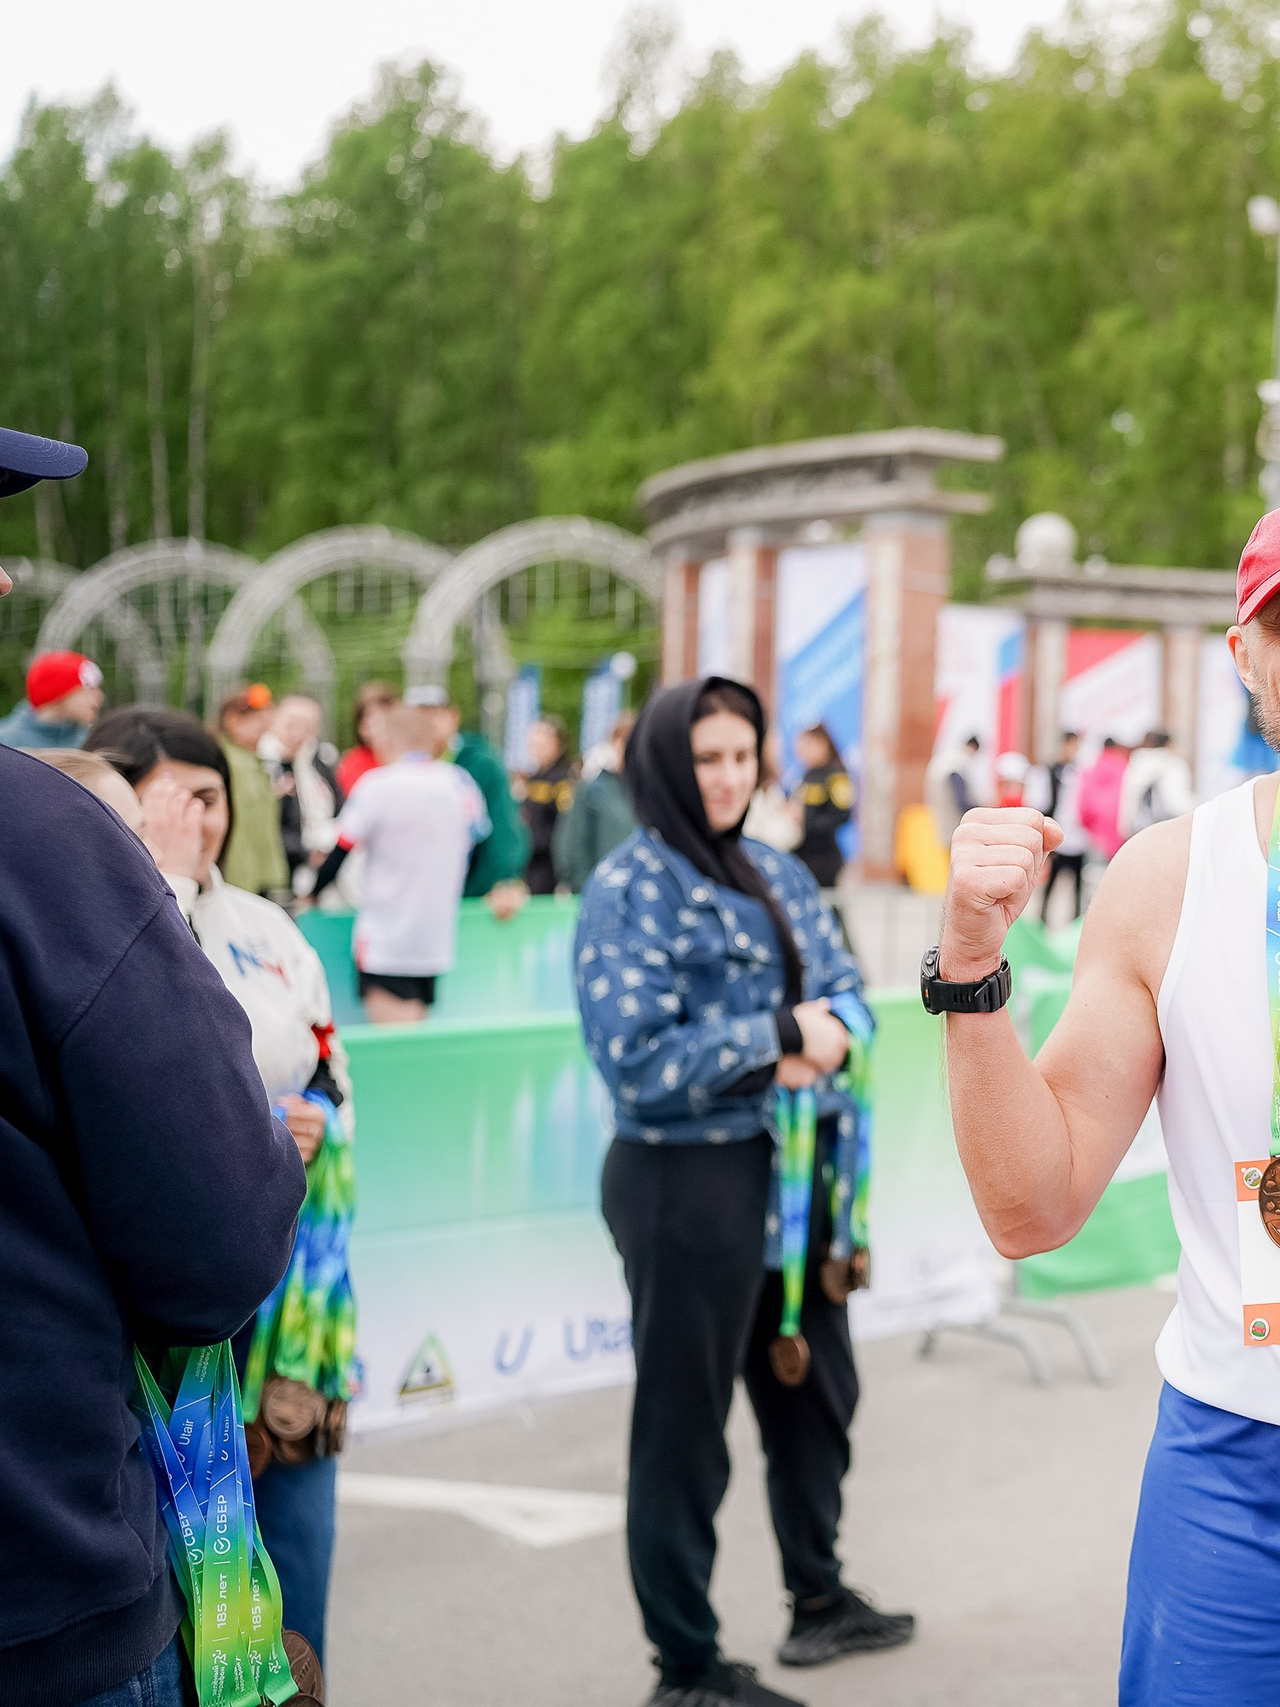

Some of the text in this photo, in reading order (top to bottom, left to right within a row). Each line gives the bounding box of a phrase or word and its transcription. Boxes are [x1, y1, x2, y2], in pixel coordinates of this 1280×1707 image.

[563, 1318, 633, 1363] Uta
[179, 1418, 194, 1446] Utair
[178, 1511, 196, 1547] СБЕР
[216, 1494, 228, 1533] СБЕР
[217, 1573, 227, 1629] 185 лет
[252, 1577, 262, 1631] 185 лет
